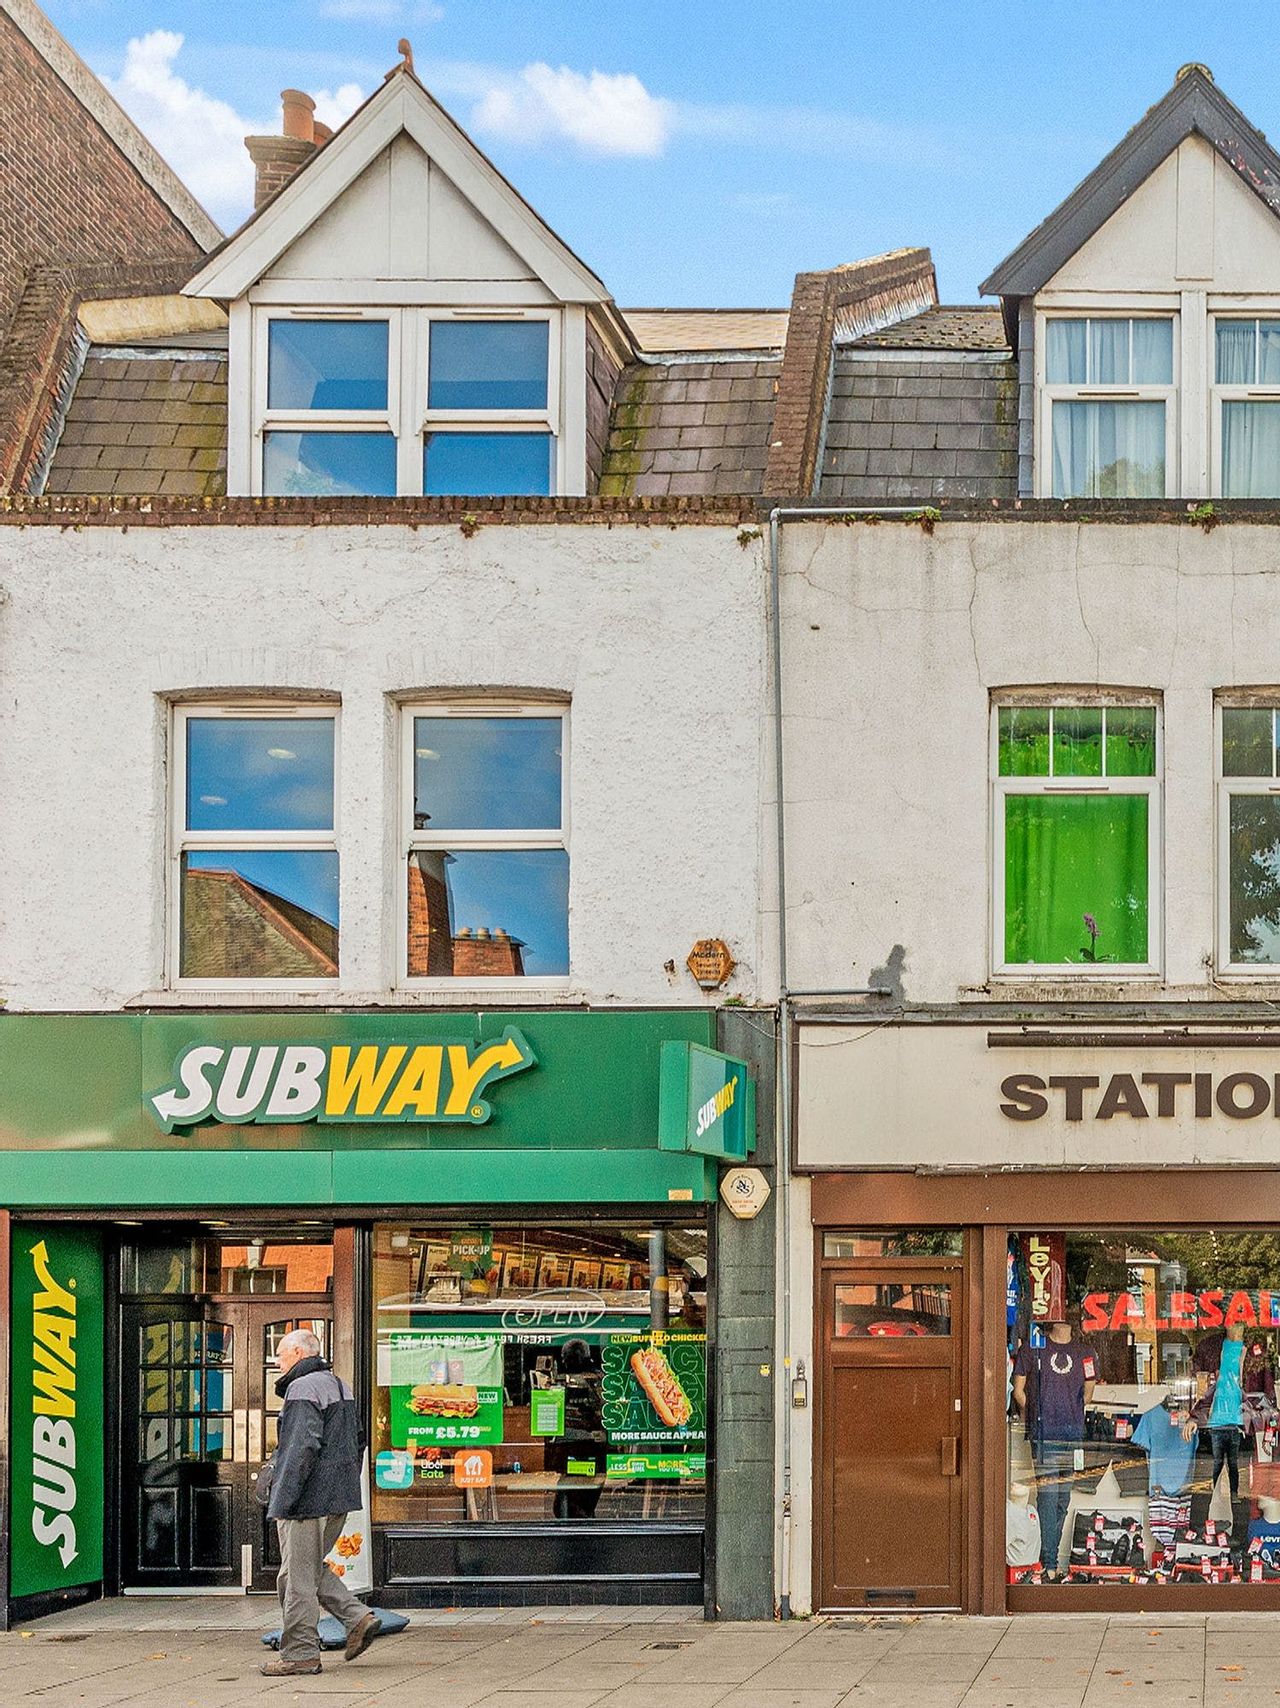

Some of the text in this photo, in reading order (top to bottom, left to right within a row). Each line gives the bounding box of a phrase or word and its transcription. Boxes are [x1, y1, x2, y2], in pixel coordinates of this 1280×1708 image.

[692, 951, 725, 959] Modern
[151, 1038, 524, 1121] SUBWAY
[696, 1074, 738, 1138] SUBWAY
[30, 1240, 78, 1568] SUBWAY
[408, 1427, 433, 1435] FROM
[435, 1426, 480, 1439] £5.79
[611, 1431, 640, 1440] MORE
[641, 1431, 672, 1440] SAUCE
[611, 1463, 627, 1471] LESS
[421, 1470, 444, 1479] Eats
